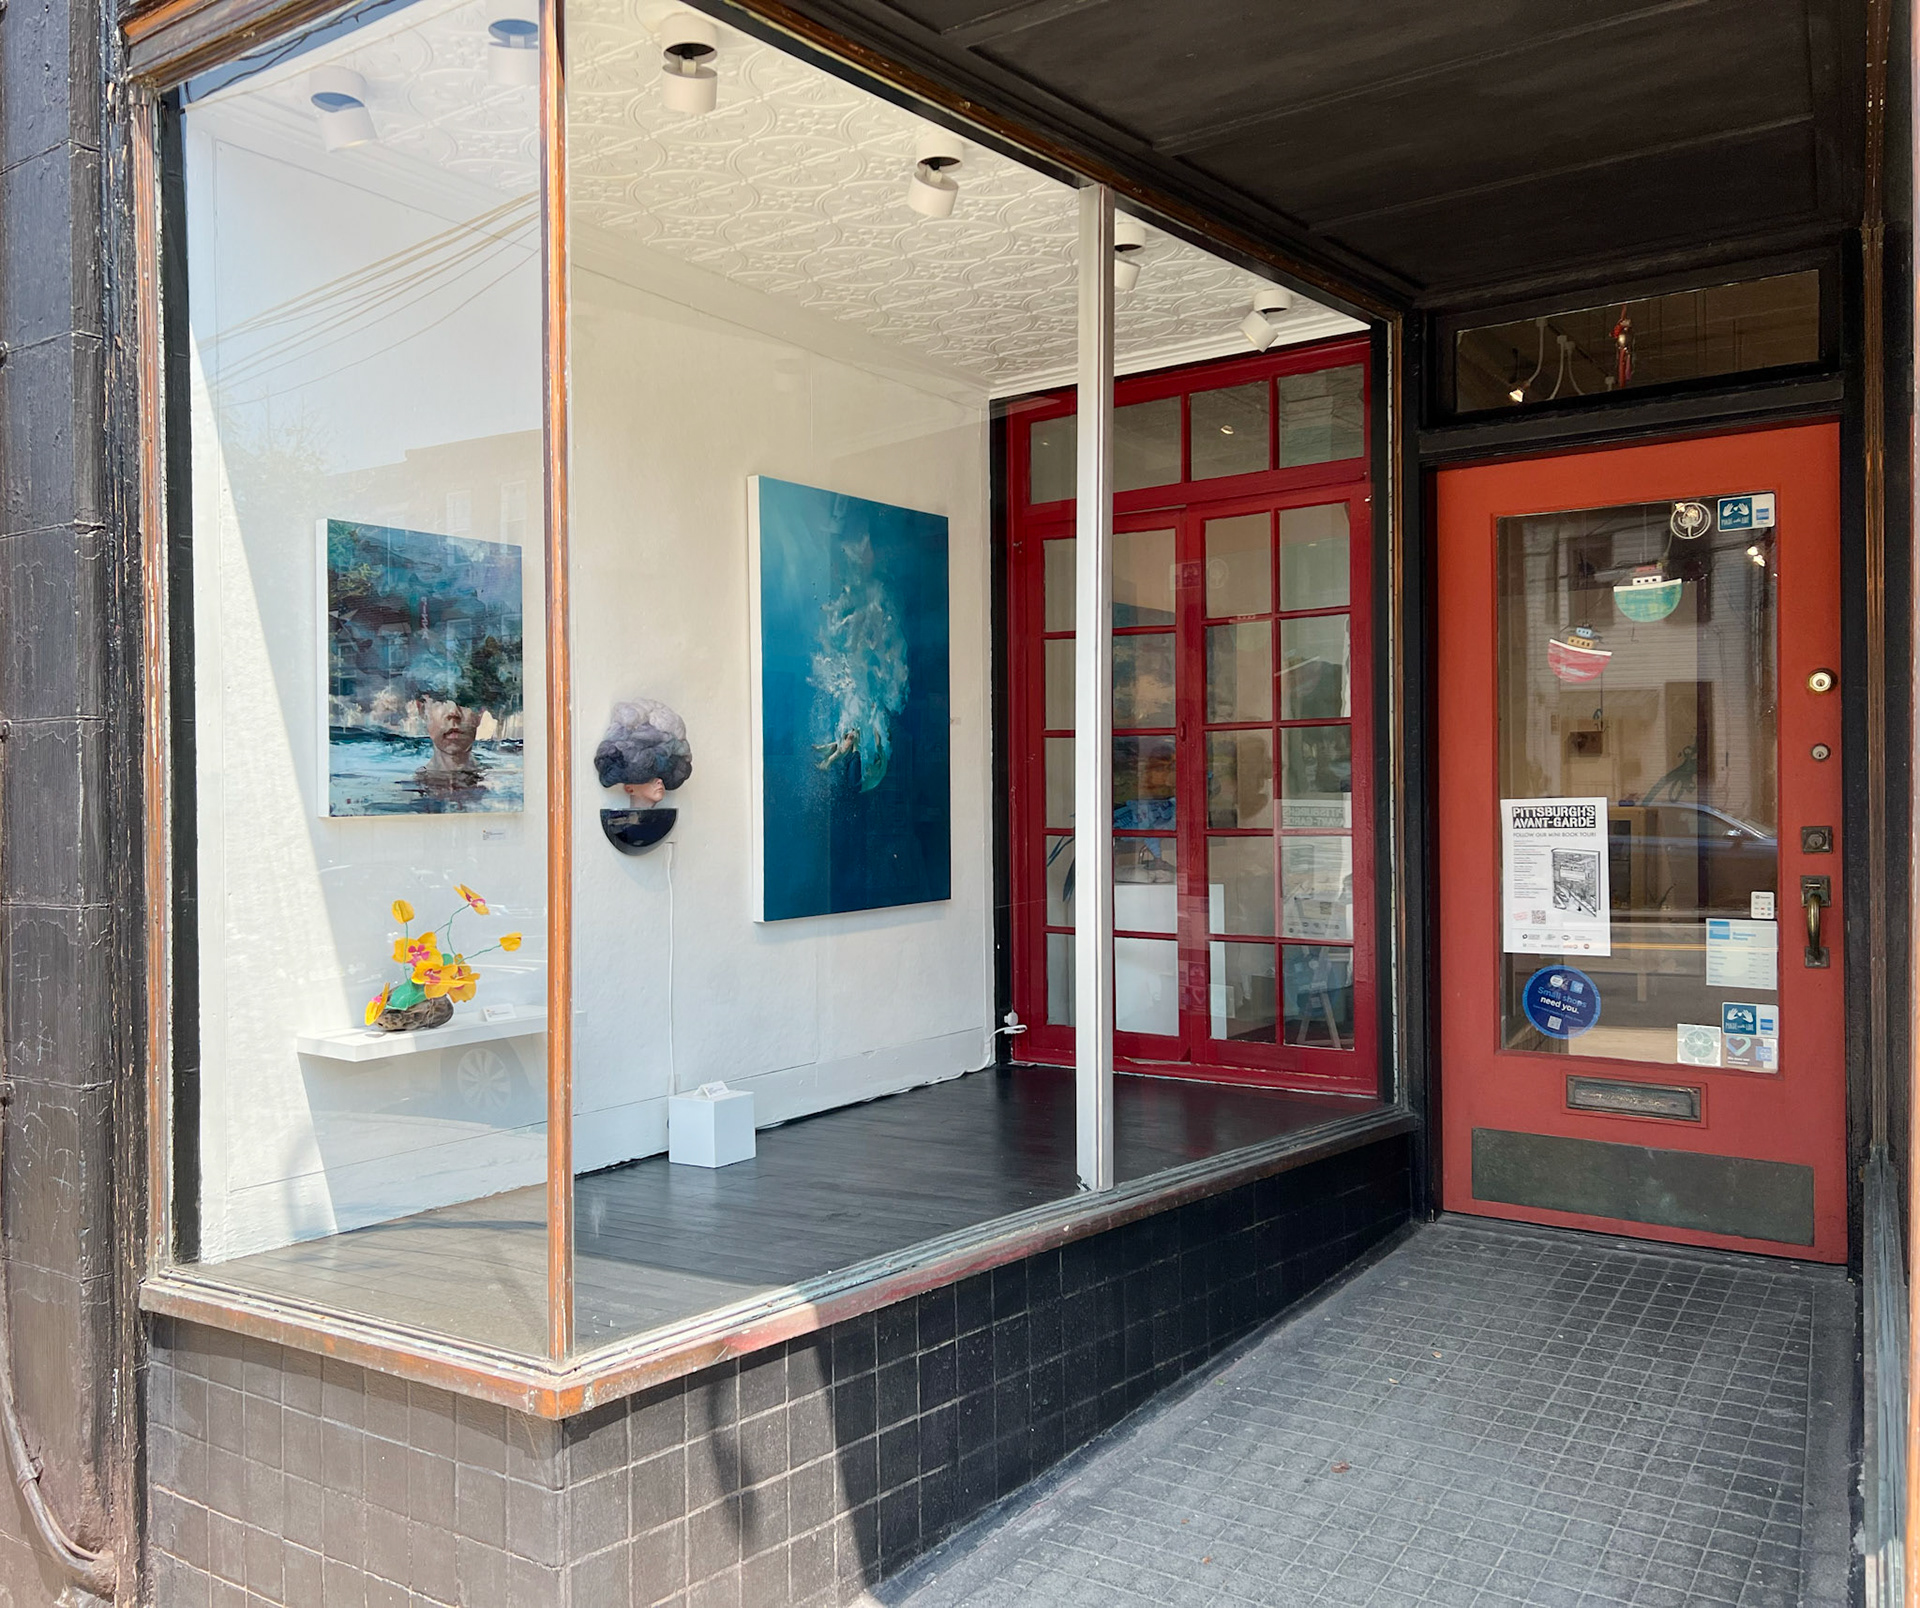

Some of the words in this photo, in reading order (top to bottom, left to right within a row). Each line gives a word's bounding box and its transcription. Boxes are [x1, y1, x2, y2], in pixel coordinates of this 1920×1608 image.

[1512, 805, 1595, 818] PITTSBURGH'S
[1513, 816, 1595, 829] AVANT-GARDE
[1537, 986, 1562, 1000] Small
[1562, 995, 1588, 1008] shops
[1540, 996, 1562, 1008] need
[1561, 1003, 1580, 1015] you.
